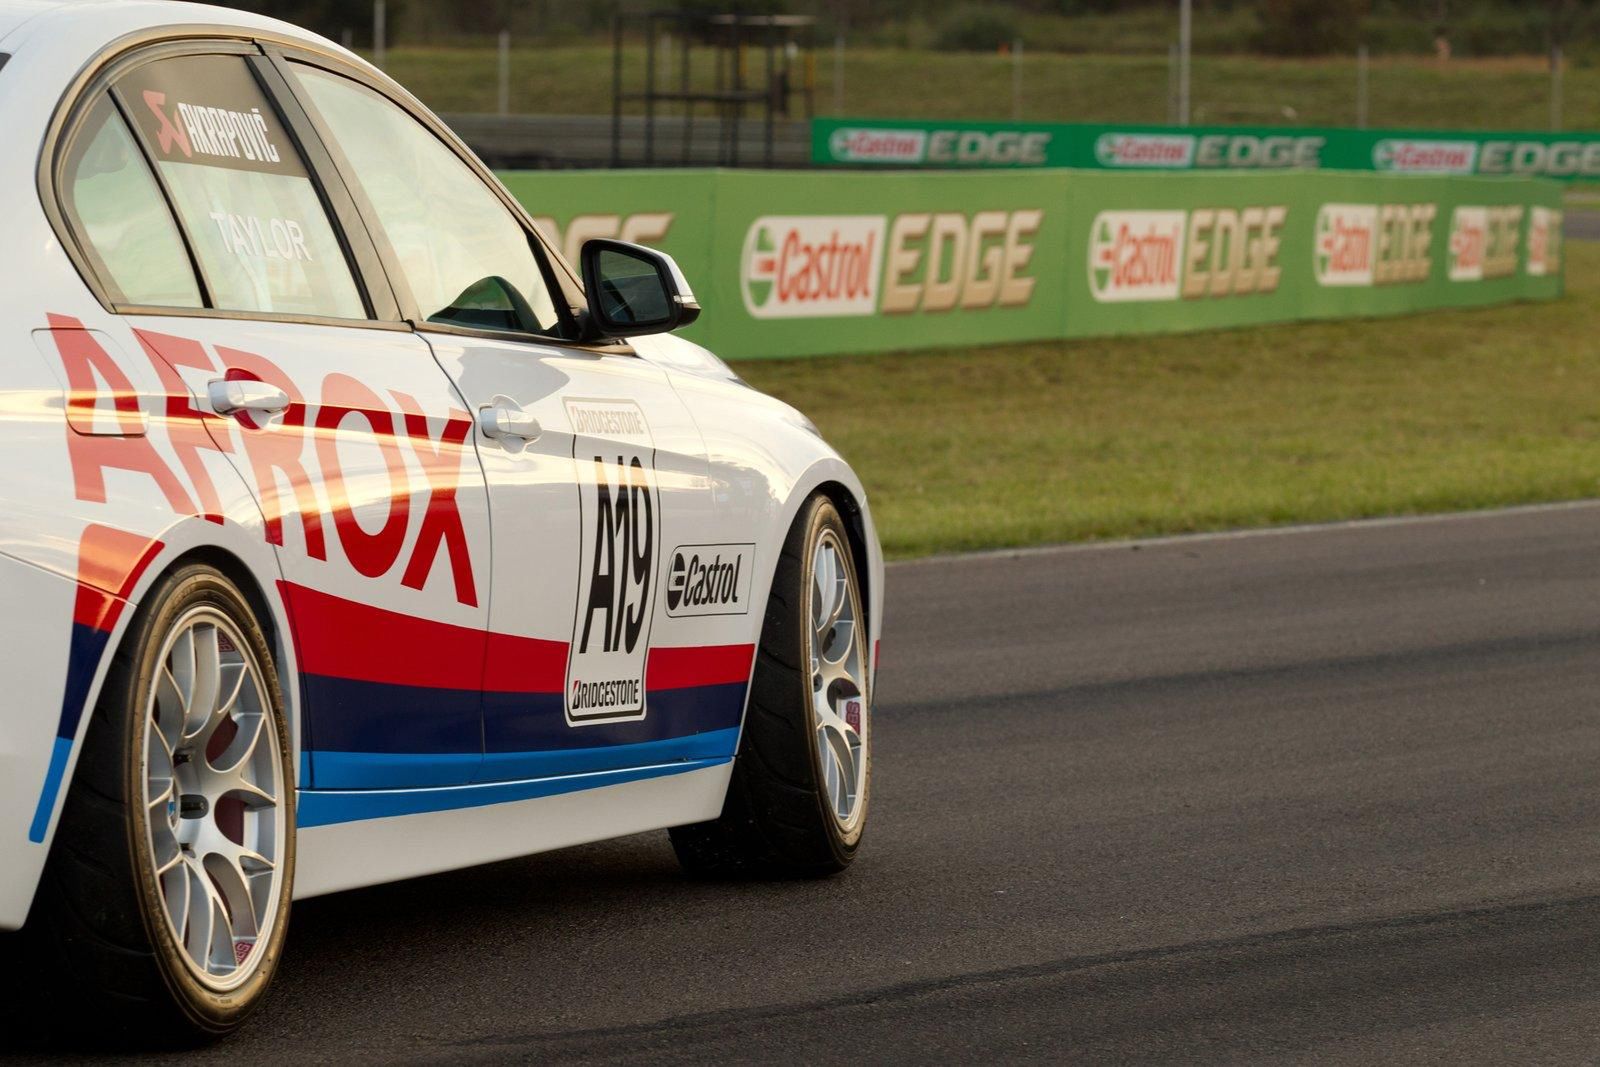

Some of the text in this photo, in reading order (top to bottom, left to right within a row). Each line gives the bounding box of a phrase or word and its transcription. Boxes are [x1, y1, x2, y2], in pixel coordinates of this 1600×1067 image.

[926, 130, 1052, 164] EDGE
[1196, 135, 1326, 168] EDGE
[209, 211, 313, 262] TAYLOR
[777, 227, 876, 303] Castrol
[880, 208, 1044, 315] EDGE
[1181, 204, 1289, 301] EDGE
[571, 405, 645, 435] BRIDGESTONE
[46, 312, 479, 608] AFROX
[579, 455, 653, 654] A19
[683, 553, 742, 607] Castrol
[572, 678, 640, 710] BRIDGESTONE
